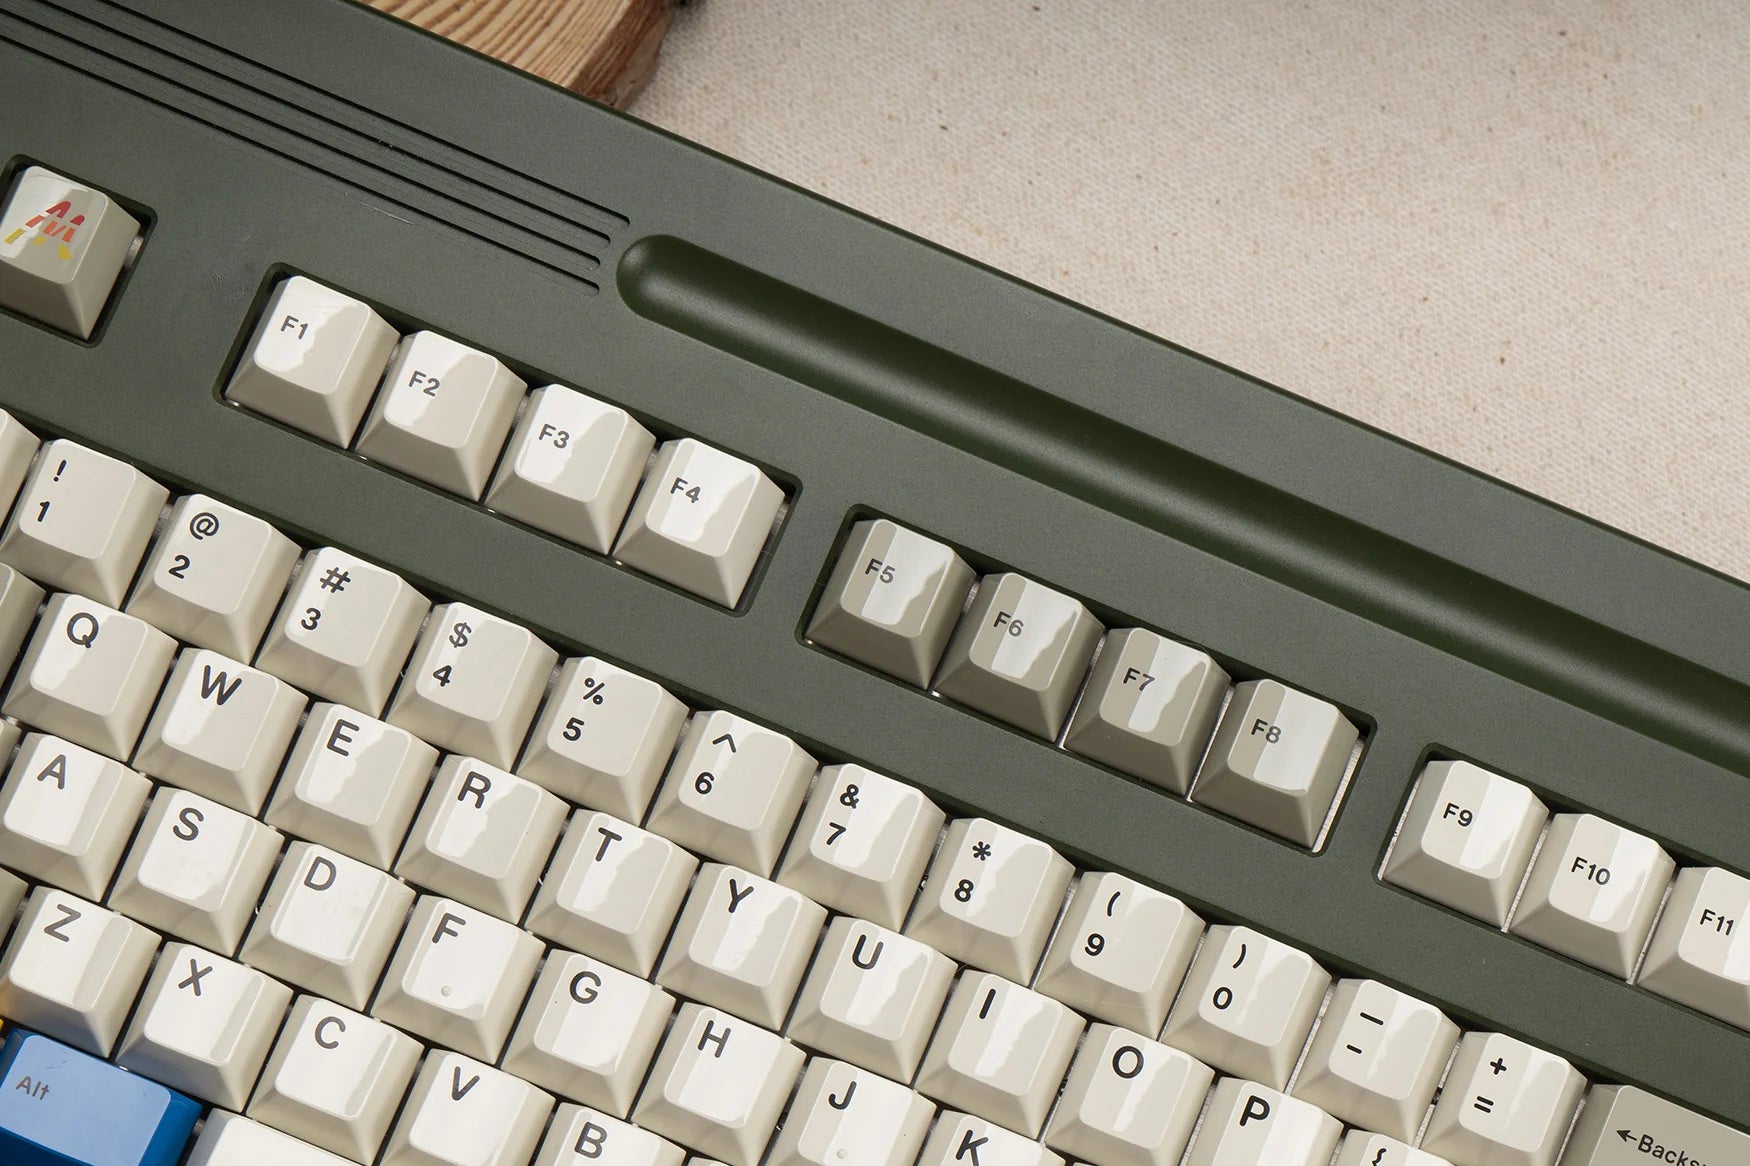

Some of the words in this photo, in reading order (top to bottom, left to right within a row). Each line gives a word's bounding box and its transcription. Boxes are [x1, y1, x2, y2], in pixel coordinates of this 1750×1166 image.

[281, 315, 308, 339] F1
[409, 371, 440, 397] F2
[539, 424, 569, 448] F3
[54, 460, 67, 482] !
[670, 477, 700, 503] F4
[37, 501, 50, 522] 1
[190, 512, 219, 540] @
[169, 555, 190, 579] 2
[320, 567, 351, 593] #
[865, 558, 895, 583] F5
[67, 612, 99, 648] Q
[301, 608, 321, 630] 3
[994, 611, 1023, 636] F6
[449, 622, 472, 648] $
[201, 665, 242, 705] W
[433, 665, 452, 687] 4
[1123, 667, 1155, 691] F7
[583, 678, 605, 705] %
[327, 719, 359, 756] E
[563, 717, 584, 741] 5
[1251, 719, 1281, 743] F8
[712, 734, 736, 753] ^
[37, 754, 66, 789] A
[695, 772, 714, 794] 6
[458, 771, 491, 809] R
[840, 784, 859, 809] &
[173, 808, 204, 841] S
[1443, 803, 1472, 827] F9
[596, 827, 622, 861] T
[826, 822, 846, 845] 7
[304, 856, 336, 891] D
[1571, 857, 1610, 885] F10
[728, 879, 754, 913] Y
[954, 879, 974, 902] 8
[1107, 891, 1120, 916] (
[44, 904, 81, 942] Z
[432, 913, 466, 943] F
[1700, 909, 1734, 935] F11
[852, 934, 883, 970] U
[1085, 933, 1104, 956] 9
[1233, 944, 1246, 968] )
[178, 959, 213, 996] X
[570, 971, 601, 1004] G
[979, 989, 996, 1019] I
[1213, 987, 1232, 1010] 0
[315, 1016, 346, 1049] C
[698, 1020, 731, 1058] H
[1112, 1046, 1144, 1079] O
[1490, 1058, 1507, 1075] +
[16, 1076, 49, 1100] Alt
[452, 1066, 480, 1101] V
[829, 1081, 857, 1110] J
[1240, 1095, 1270, 1126] P
[1474, 1096, 1494, 1113] =
[574, 1122, 607, 1158] B
